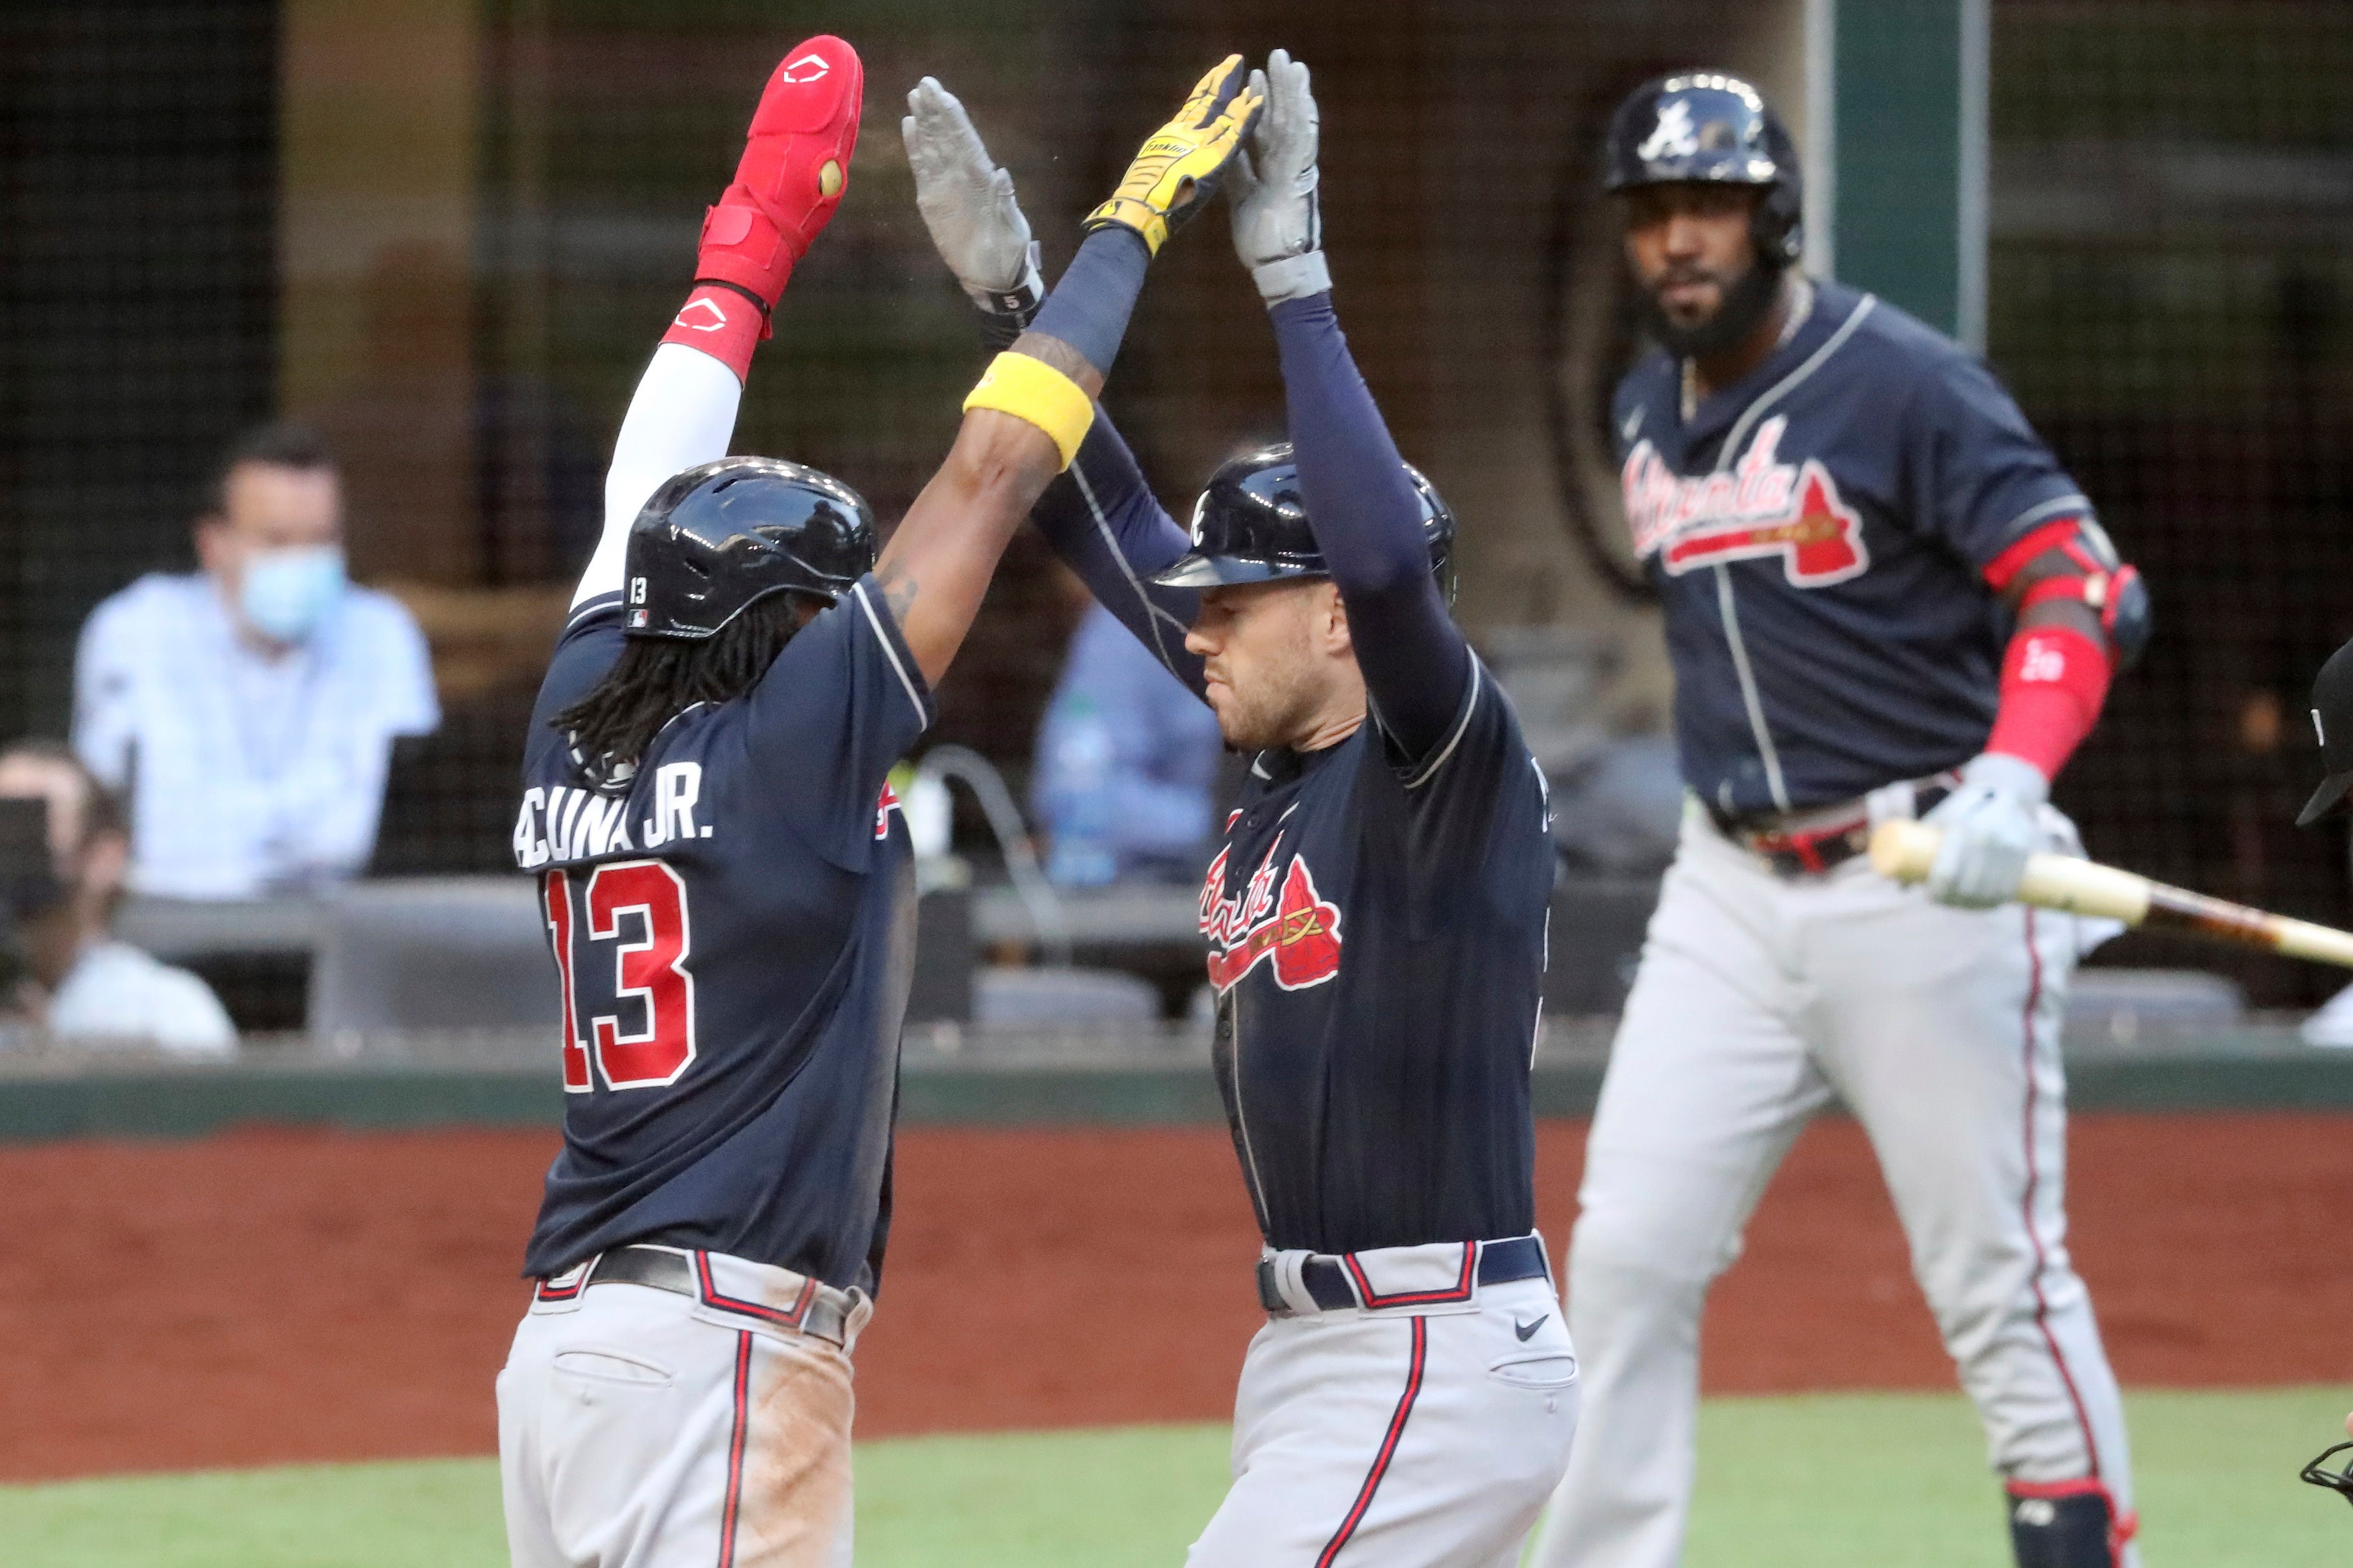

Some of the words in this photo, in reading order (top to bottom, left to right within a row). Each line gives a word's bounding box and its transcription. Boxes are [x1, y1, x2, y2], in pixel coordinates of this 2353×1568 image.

[1003, 295, 1020, 309] 5
[630, 576, 647, 604] 13
[643, 761, 713, 849] JR.
[545, 857, 696, 1093] 13
